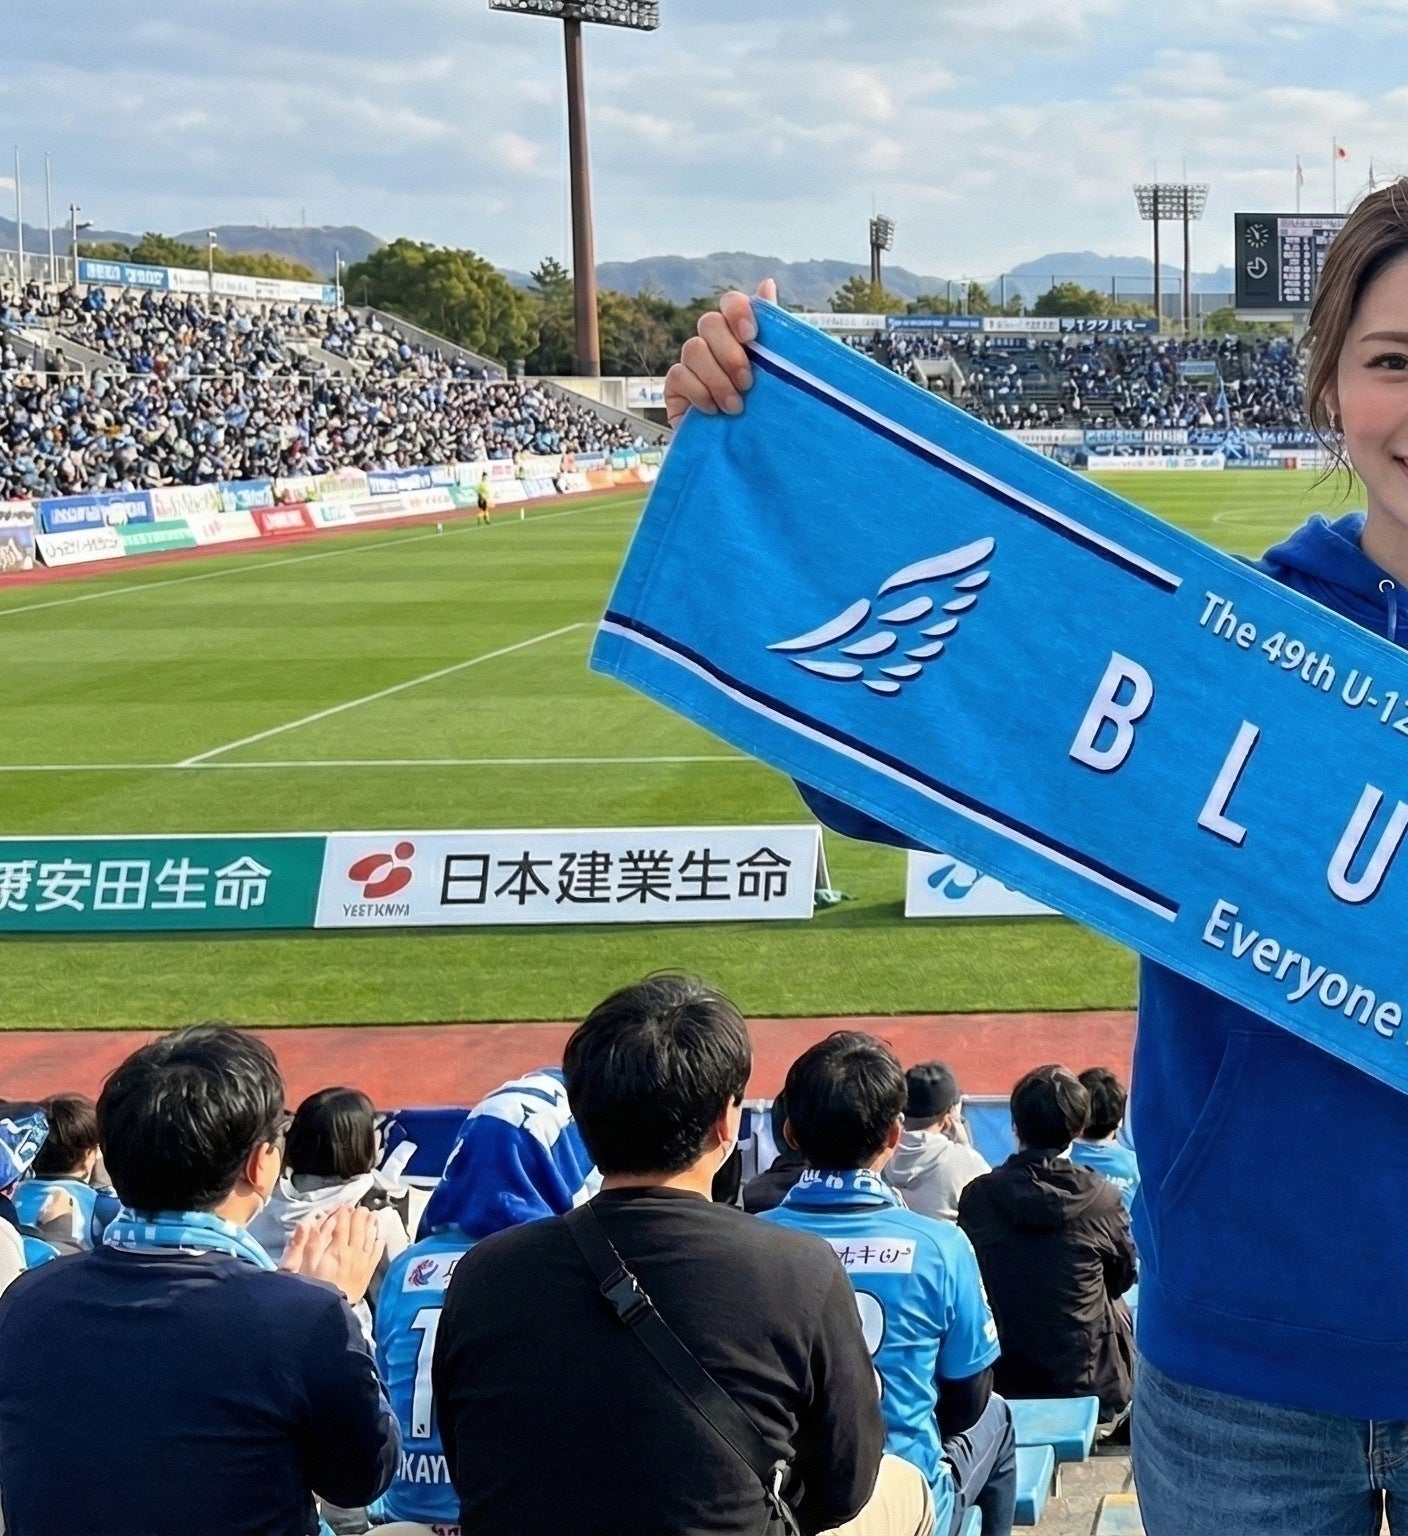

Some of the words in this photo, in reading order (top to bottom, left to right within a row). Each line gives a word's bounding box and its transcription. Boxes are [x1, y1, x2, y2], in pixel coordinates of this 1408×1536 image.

[1200, 591, 1257, 649] The
[1261, 631, 1336, 692] 49th
[440, 847, 792, 905] 日本建業生命
[1202, 898, 1403, 1037] Everyone
[397, 1450, 452, 1484] KAY
